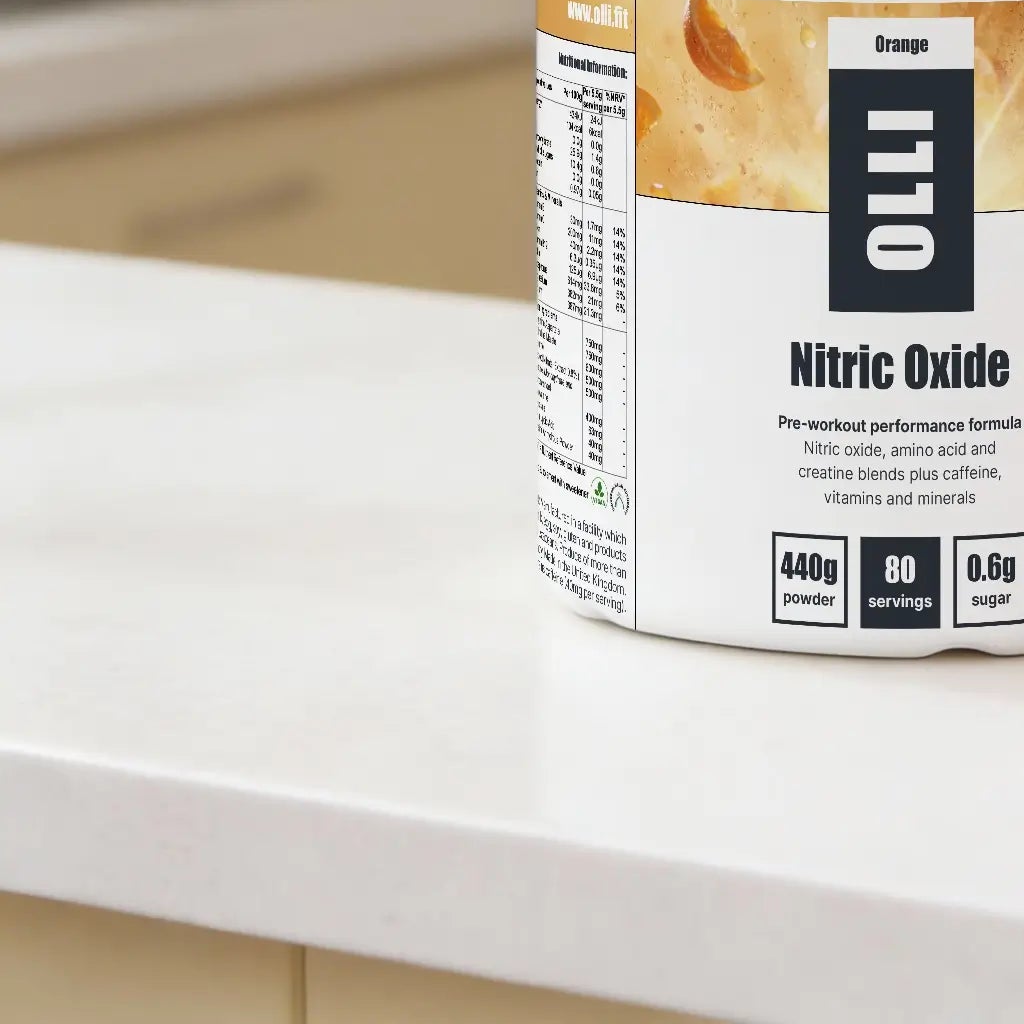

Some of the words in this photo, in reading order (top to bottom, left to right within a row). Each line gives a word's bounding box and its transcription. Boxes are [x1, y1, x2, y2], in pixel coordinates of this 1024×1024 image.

[567, 0, 629, 30] www.olli.fit
[875, 34, 929, 55] Orange
[866, 110, 935, 271] OLLI
[790, 341, 895, 390] Nitric
[904, 342, 1010, 390] Oxide
[778, 415, 866, 433] Pre-workout
[870, 419, 965, 436] performance
[968, 416, 1022, 432] formula
[804, 440, 840, 456] Nitric
[844, 442, 886, 460] oxide,
[891, 443, 934, 457] amino
[938, 442, 967, 456] acid
[971, 440, 996, 456] and
[798, 465, 854, 480] creatine
[858, 467, 905, 481] blends
[910, 467, 939, 484] plus
[942, 465, 1002, 482] caffeine,
[824, 491, 882, 505] vitamins
[886, 492, 913, 506] and
[917, 491, 976, 505] minerals
[594, 543, 627, 562] products
[780, 551, 838, 586] 440g
[884, 555, 916, 584] 80
[966, 552, 1016, 584] 0.6g
[783, 591, 836, 607] powder
[868, 594, 932, 612] servings
[971, 592, 1012, 609] sugar
